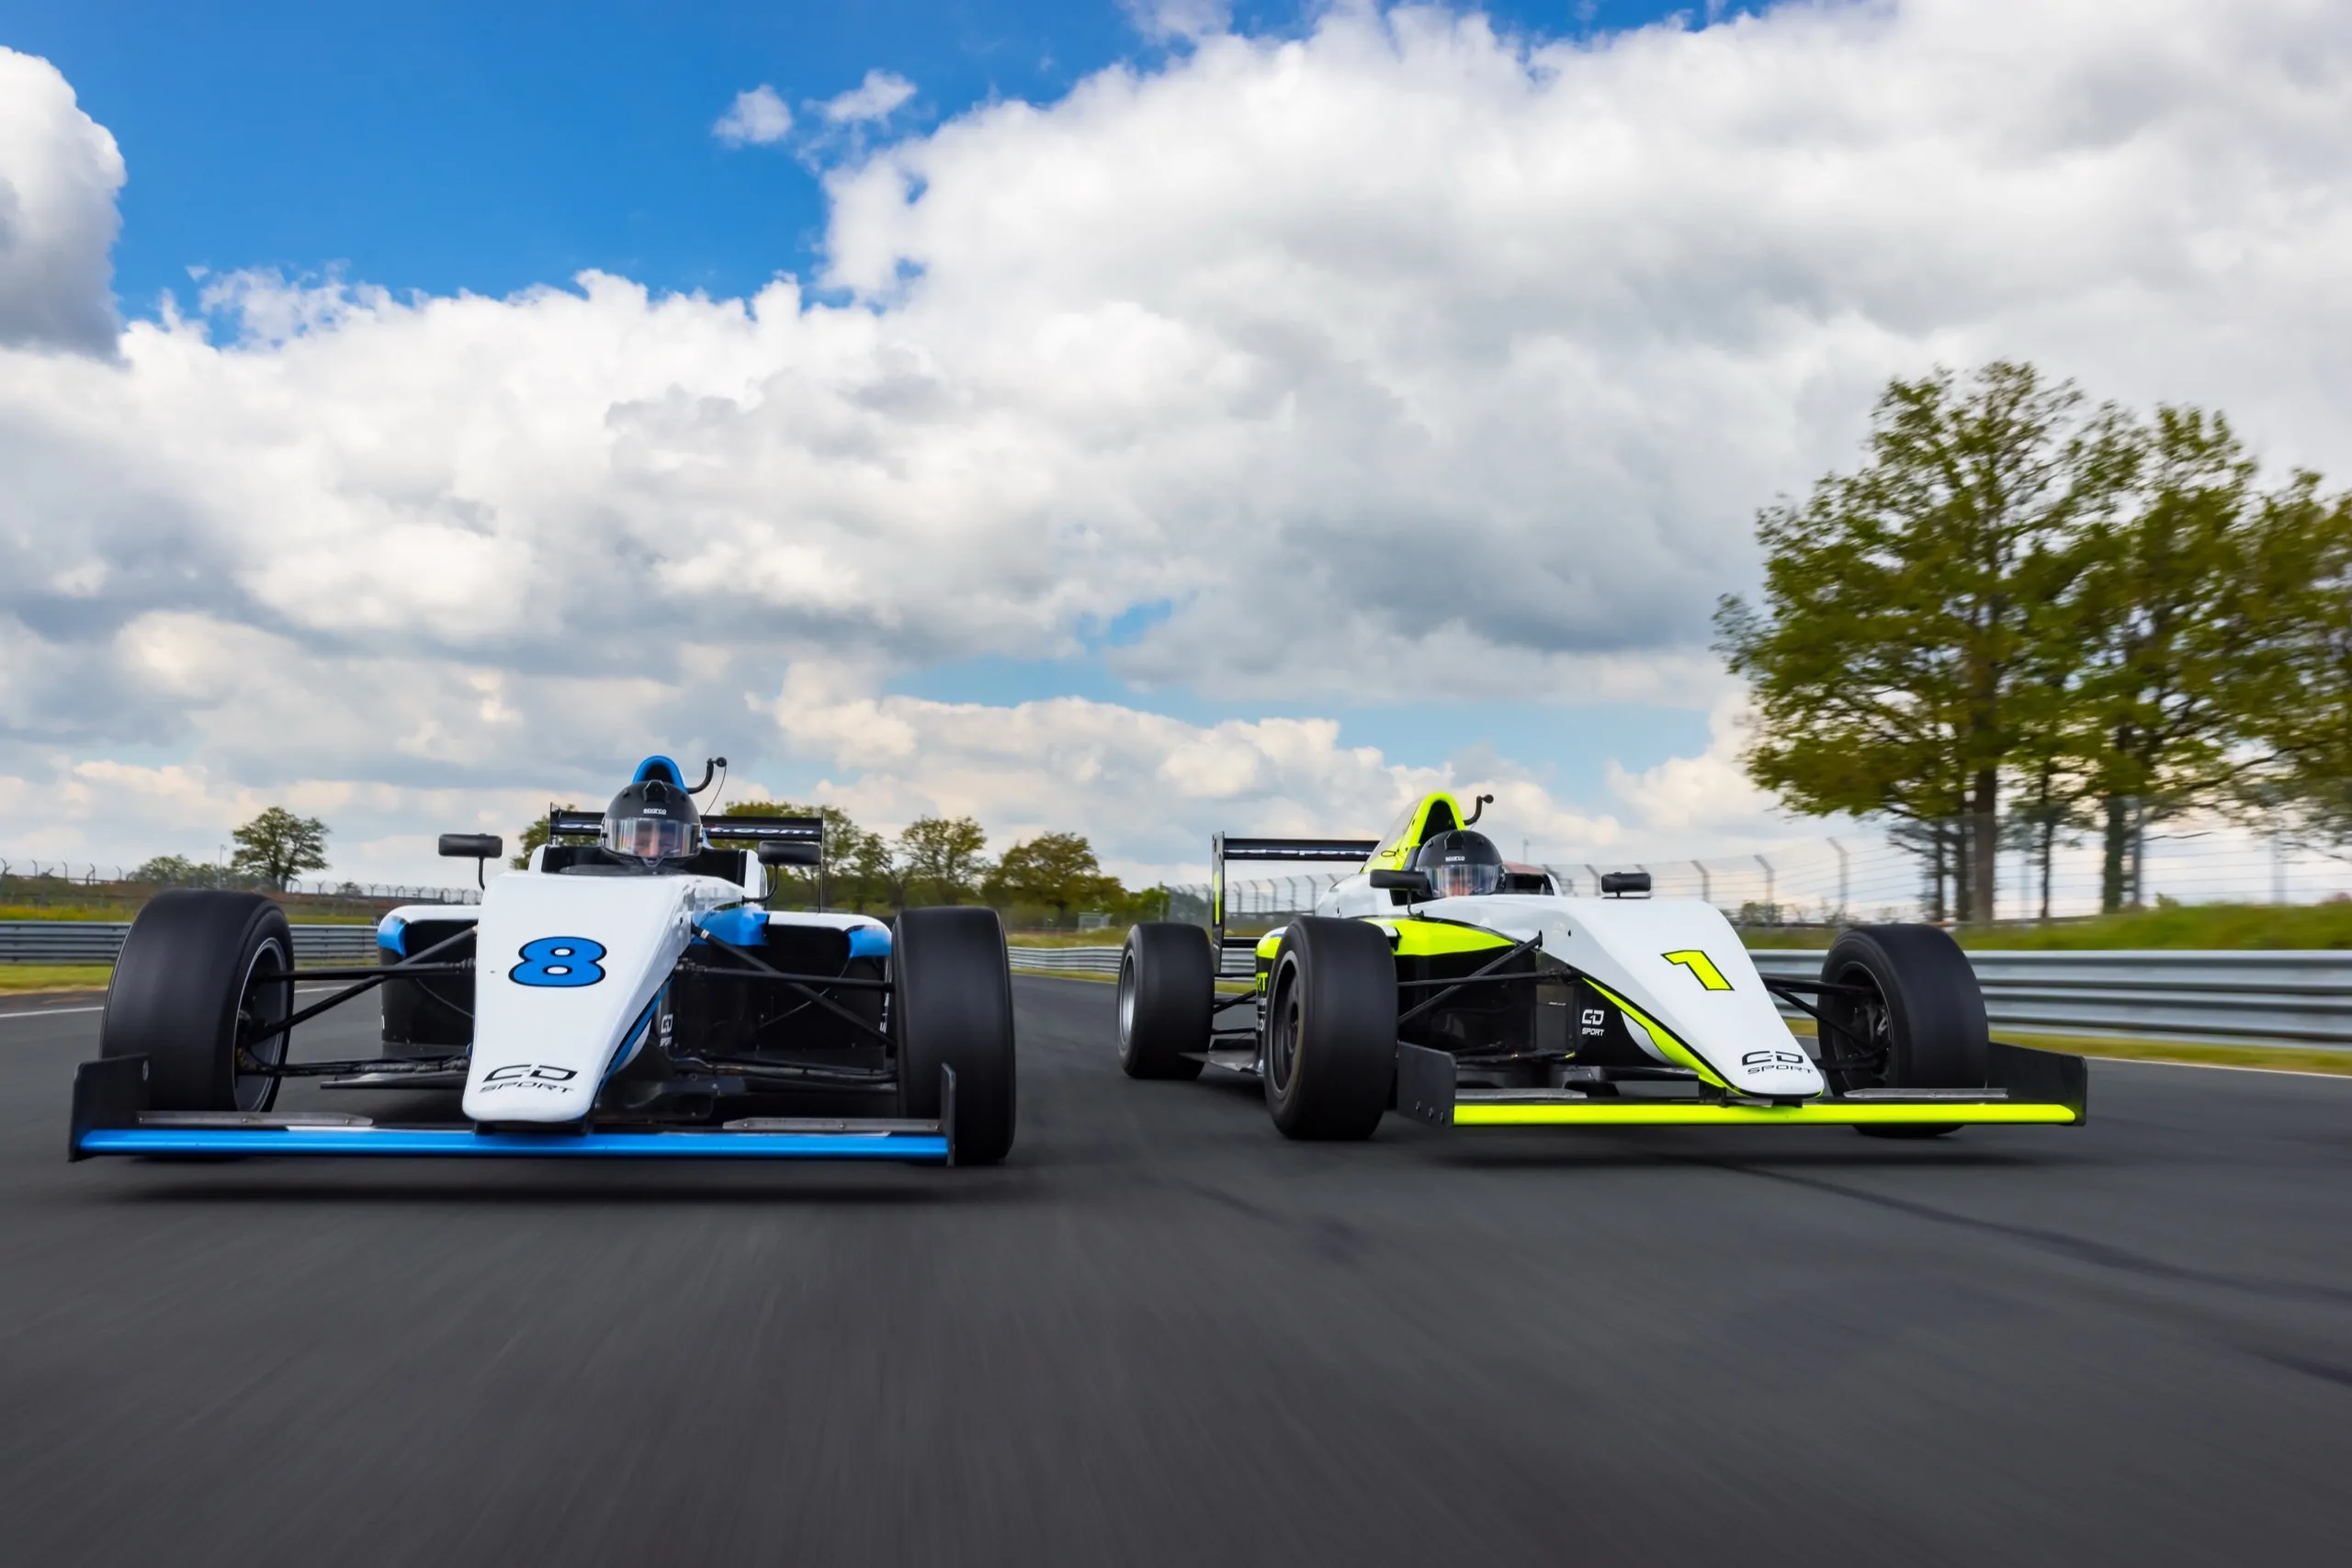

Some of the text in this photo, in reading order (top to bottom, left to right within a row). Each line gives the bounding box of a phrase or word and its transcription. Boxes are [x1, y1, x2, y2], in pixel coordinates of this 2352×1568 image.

[508, 936, 607, 987] 8
[1660, 950, 1736, 991] 1
[1581, 1027, 1605, 1036] SPORT
[1747, 1065, 1814, 1075] SPORT
[479, 1081, 575, 1094] SPORT
